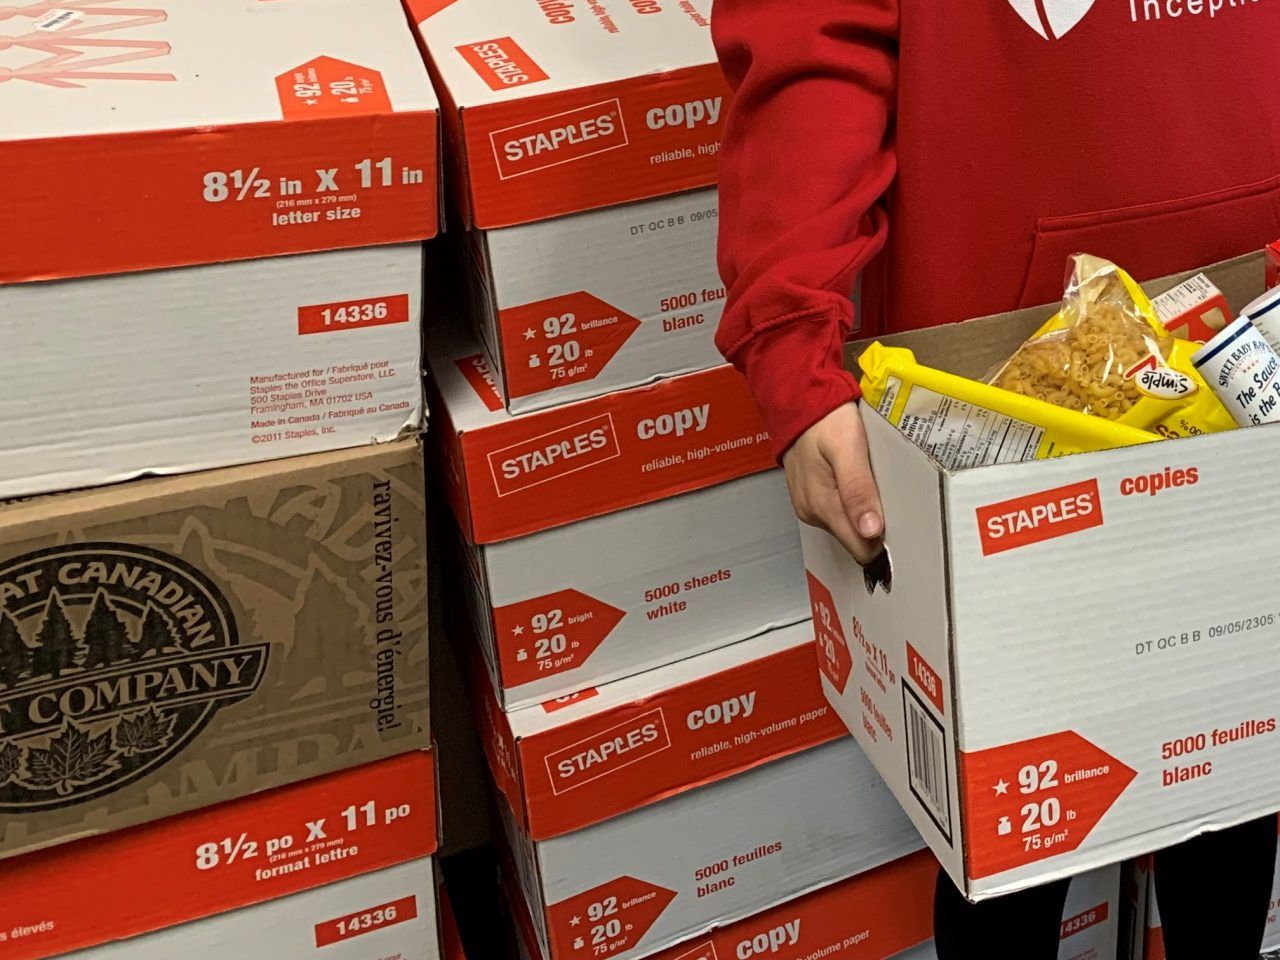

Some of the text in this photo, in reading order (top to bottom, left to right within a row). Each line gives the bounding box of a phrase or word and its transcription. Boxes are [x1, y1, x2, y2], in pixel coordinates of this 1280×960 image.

[504, 96, 723, 161] STAPLES copy
[202, 167, 272, 204] 8½
[279, 175, 303, 196] in
[354, 156, 393, 188] 11
[402, 166, 424, 185] in
[272, 204, 361, 227] letter size
[320, 301, 388, 326] 14336
[250, 370, 310, 384] Manufactured
[312, 369, 323, 377] for
[332, 362, 368, 374] Fabriqué
[370, 361, 389, 370] pour
[1142, 373, 1188, 394] Simple
[1219, 343, 1252, 388] SWEET BABY
[1236, 356, 1279, 409] The Sauce
[250, 384, 283, 395] Staples
[301, 378, 326, 387] Office
[329, 373, 376, 385] Superstore,
[251, 389, 326, 405] 500 Staples Drive
[251, 403, 307, 414] Framingham,
[326, 395, 353, 404] 01702
[355, 392, 373, 400] USA
[1258, 395, 1277, 418] the
[501, 403, 710, 480] STAPLES copy
[986, 466, 1200, 540] STAPLES copies
[373, 480, 400, 624] ravivez-vous
[644, 568, 732, 603] 5000 sheets
[58, 562, 217, 649] CANADIAN
[531, 609, 594, 634] 92 bright
[646, 600, 688, 621] white
[28, 655, 252, 724] COMPANY
[557, 690, 757, 779] STAPLES copy
[690, 706, 829, 761] reliable, high-volume paper
[1161, 717, 1277, 760] 5000 feuilles
[1017, 759, 1110, 795] 92 brillance
[1162, 760, 1213, 787] blanc
[1020, 797, 1077, 833] 20 lb
[255, 844, 359, 881] format lettre
[694, 840, 783, 882] 5000 feuilles
[1023, 836, 1042, 853] 75
[695, 874, 736, 899] blanc
[11, 920, 55, 940] élevés
[336, 905, 397, 936] 14336
[736, 918, 801, 960] copy
